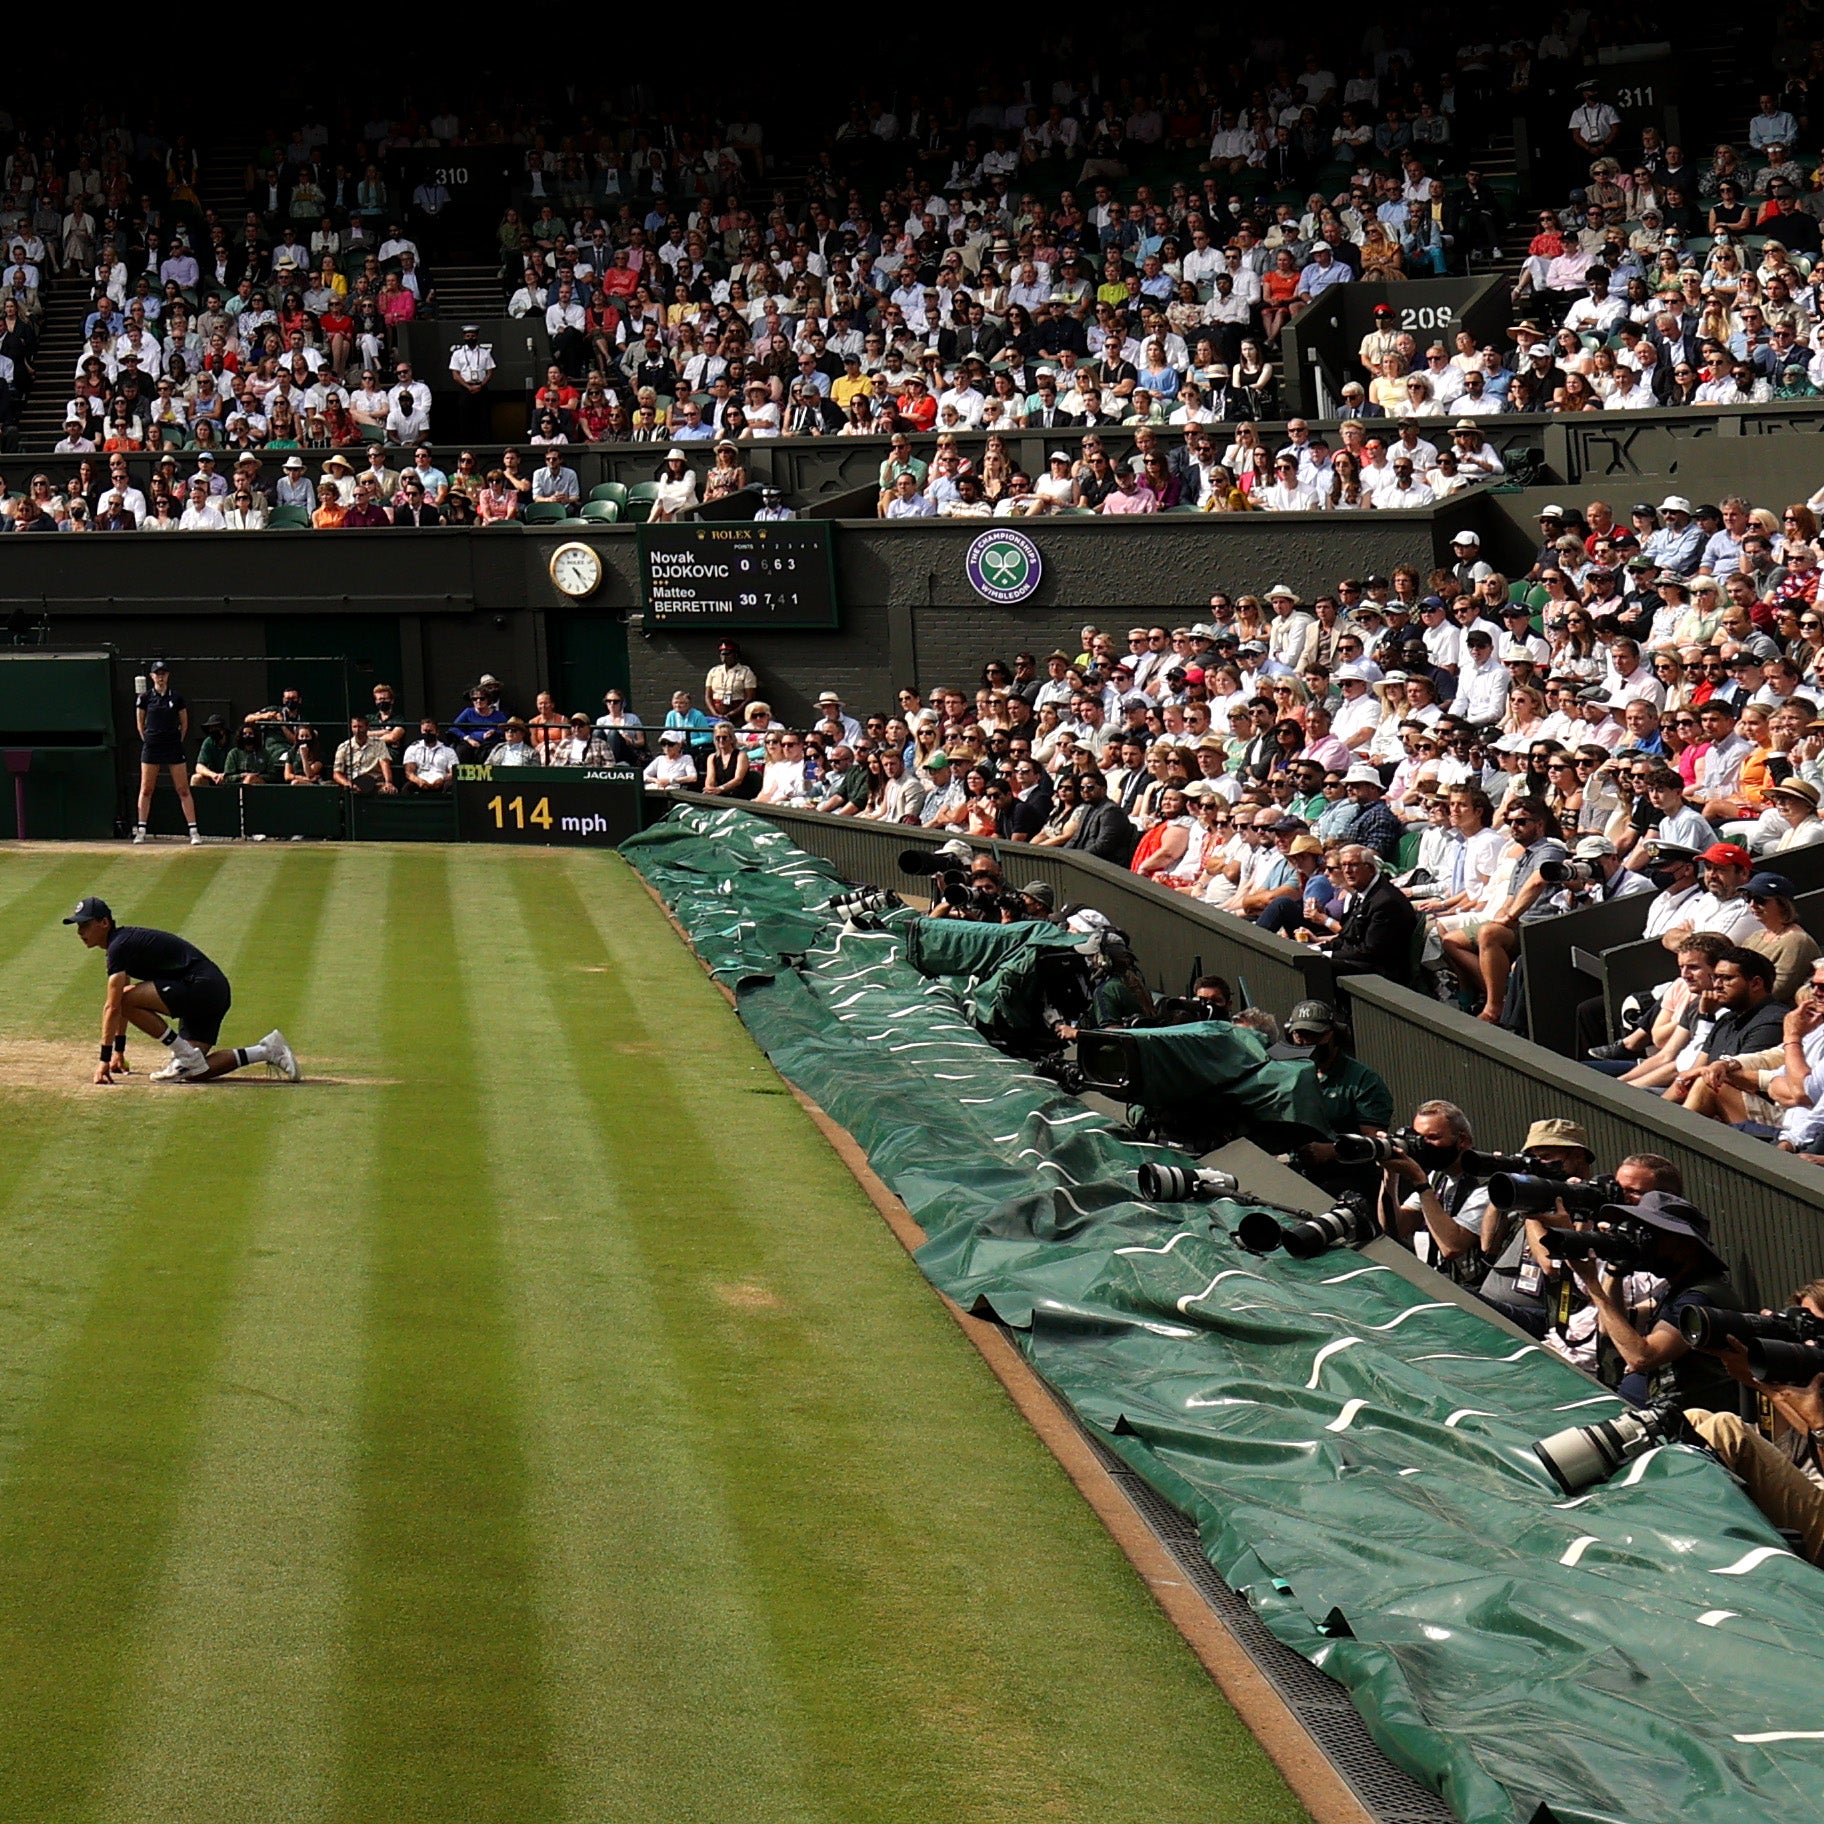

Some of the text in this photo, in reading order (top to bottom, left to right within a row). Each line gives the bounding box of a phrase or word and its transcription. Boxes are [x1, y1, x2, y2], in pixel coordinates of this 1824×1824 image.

[1617, 86, 1653, 107] 311
[435, 167, 468, 184] 310
[1400, 306, 1452, 330] 208
[711, 529, 752, 540] ROLEX
[650, 550, 695, 564] Novak
[970, 532, 1037, 565] THE CHAMPIONSHIPS
[651, 558, 795, 578] DJOKOVIC 0 6 6 3
[652, 586, 696, 598] Matteo
[981, 582, 1031, 600] WIMBLEDON
[654, 600, 733, 613] BERRETTINI
[739, 593, 757, 606] 30
[764, 593, 772, 604] 7
[791, 593, 798, 605] 1
[456, 764, 493, 781] IBM
[583, 771, 635, 780] JAGUAR
[487, 795, 553, 830] 114
[561, 813, 608, 835] mph
